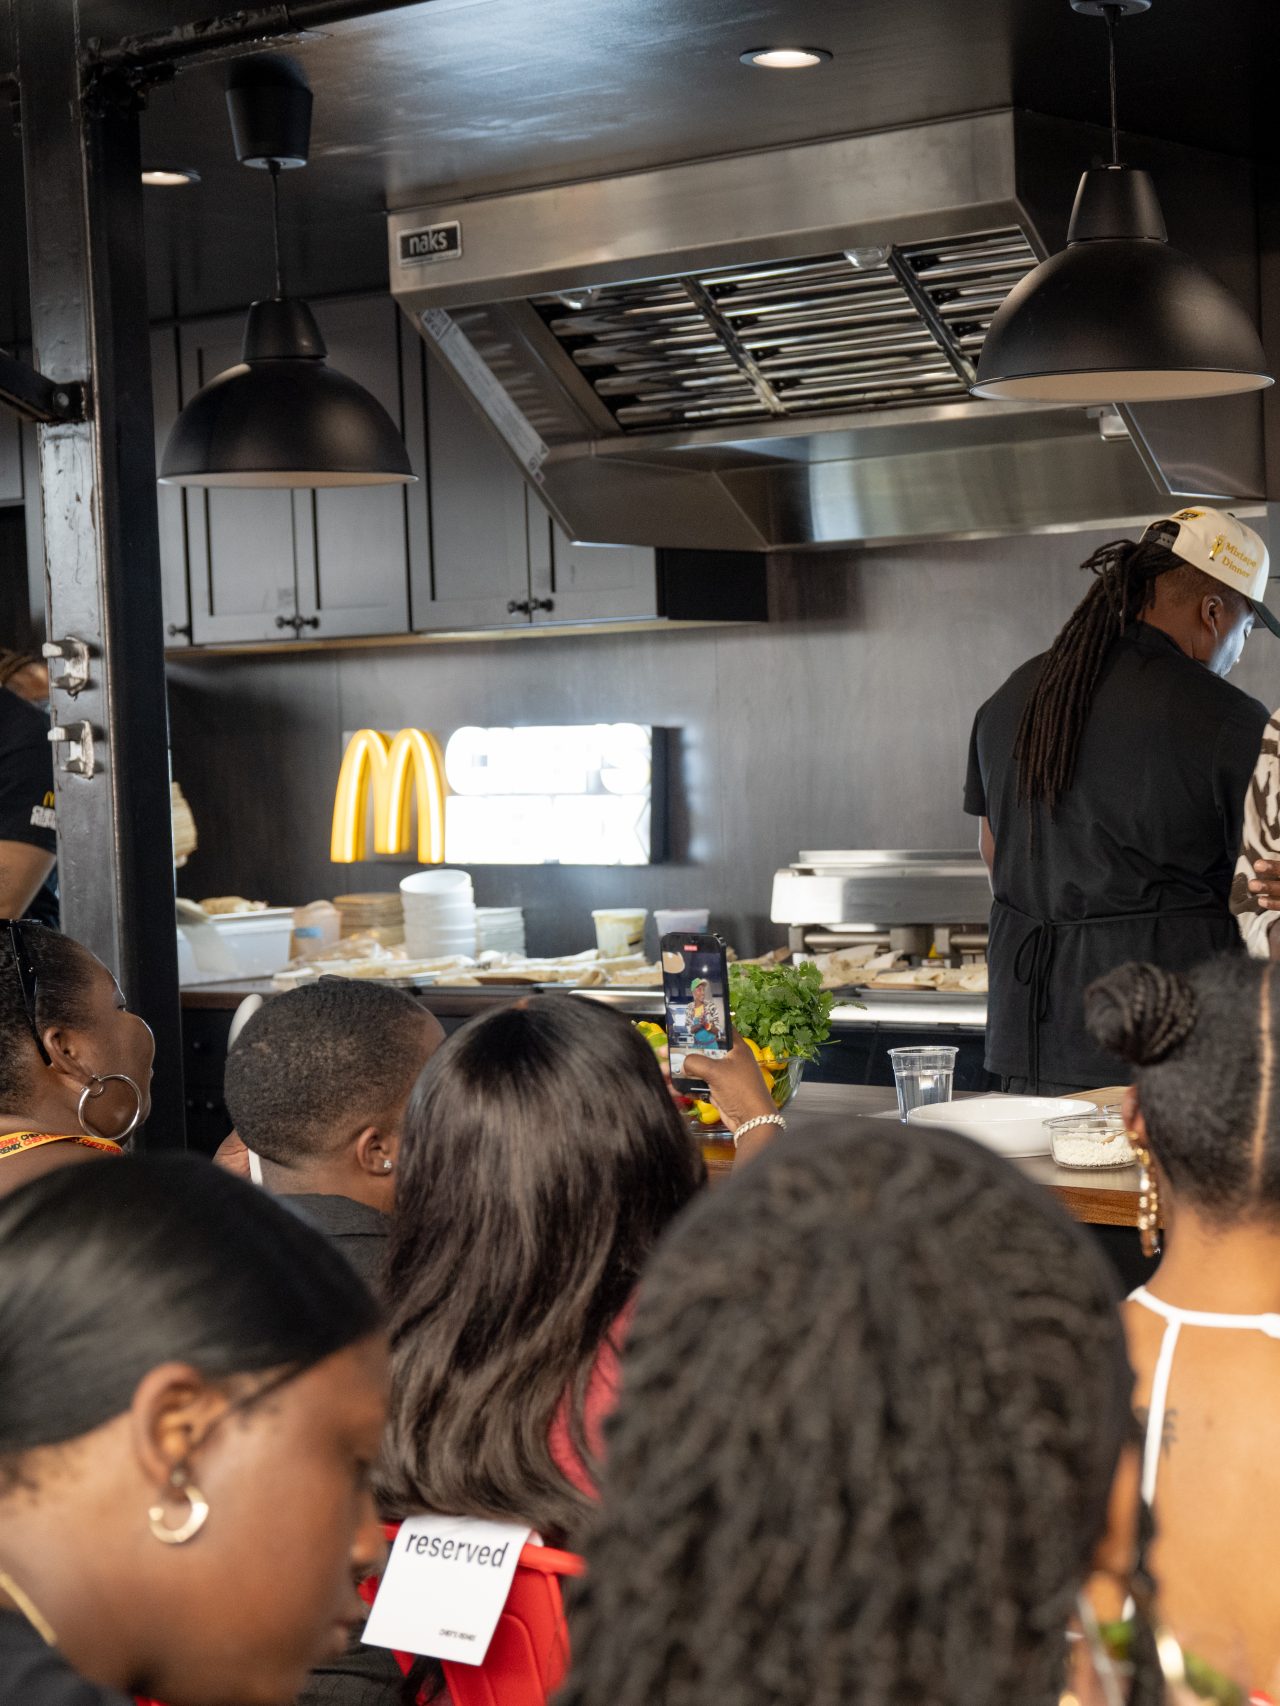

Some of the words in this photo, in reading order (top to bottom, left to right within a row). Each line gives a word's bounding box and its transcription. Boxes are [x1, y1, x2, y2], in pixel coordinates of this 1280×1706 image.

[409, 229, 449, 256] naks
[1221, 556, 1251, 578] Dinner
[1225, 543, 1257, 568] Mixtape
[405, 1533, 509, 1568] reserved
